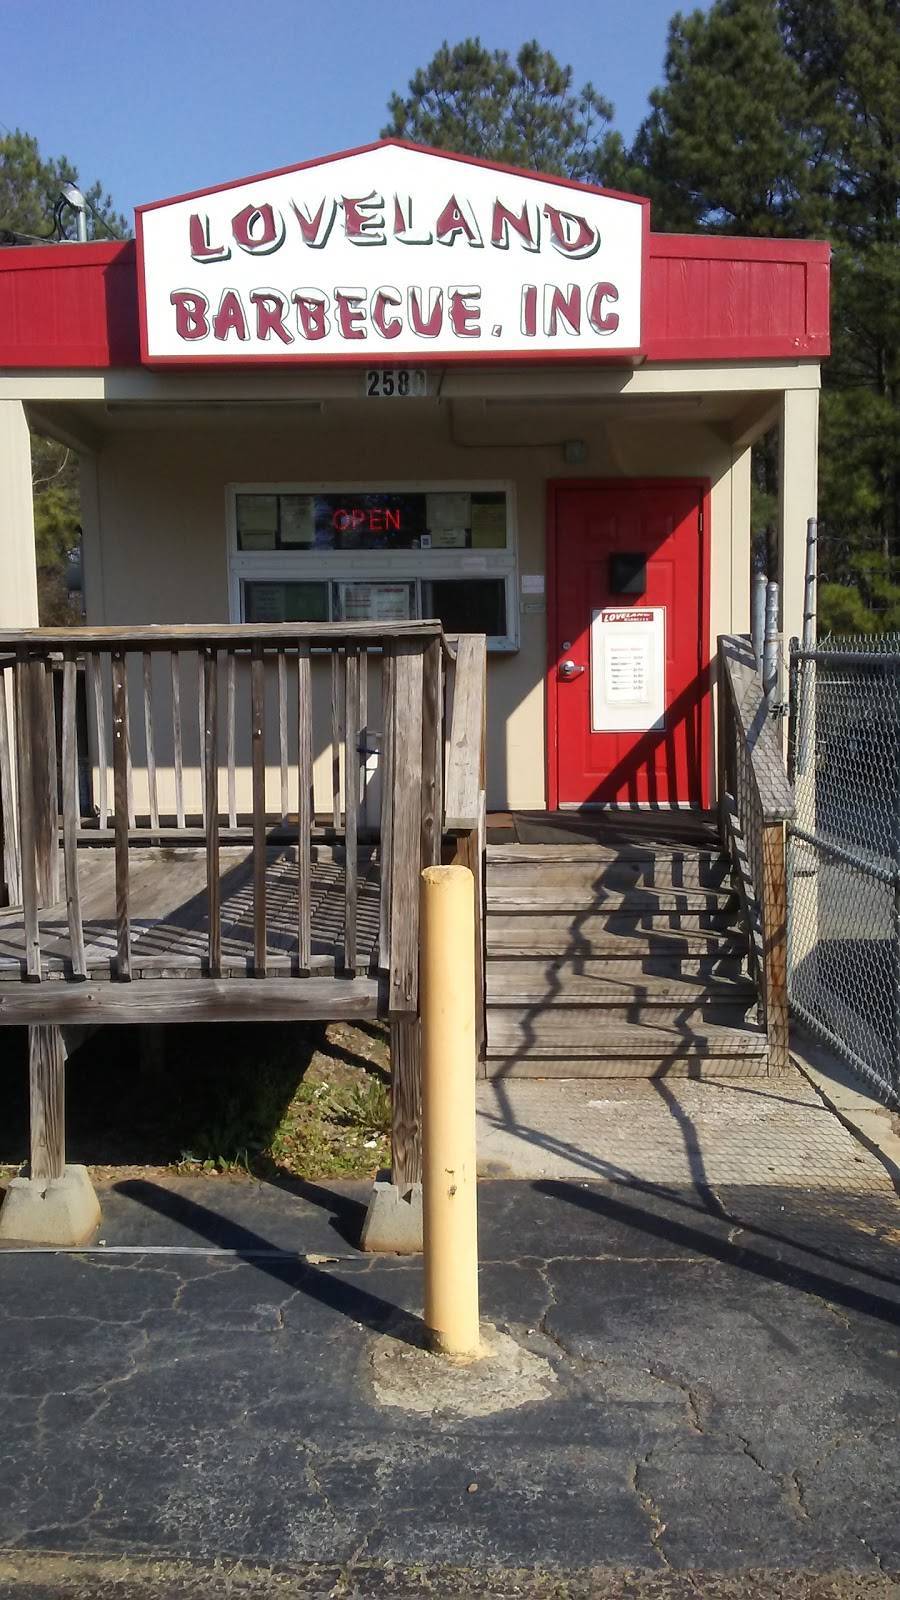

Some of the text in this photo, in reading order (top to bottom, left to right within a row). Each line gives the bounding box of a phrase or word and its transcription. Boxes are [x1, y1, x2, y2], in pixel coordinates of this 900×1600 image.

[189, 191, 601, 264] LOVELAND
[520, 282, 619, 338] INC
[333, 508, 401, 530] OPEN
